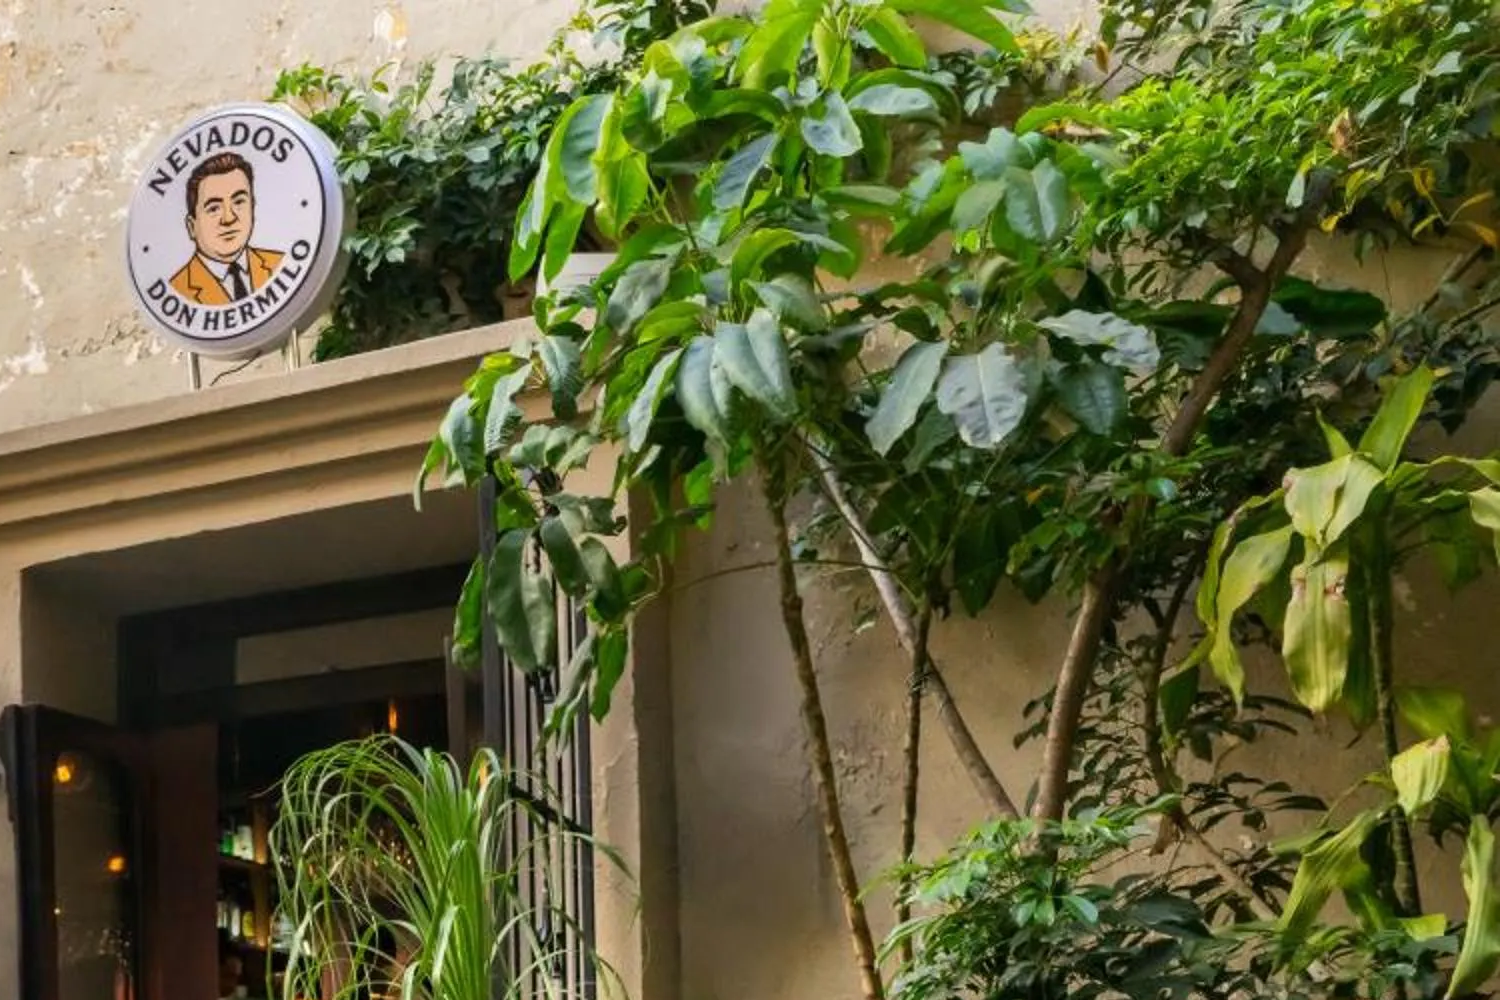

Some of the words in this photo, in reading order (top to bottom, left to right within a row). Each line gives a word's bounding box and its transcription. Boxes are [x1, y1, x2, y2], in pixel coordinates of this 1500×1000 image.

[148, 121, 295, 197] NEVADOS
[147, 278, 197, 330] DON
[203, 239, 311, 331] HERMILO
